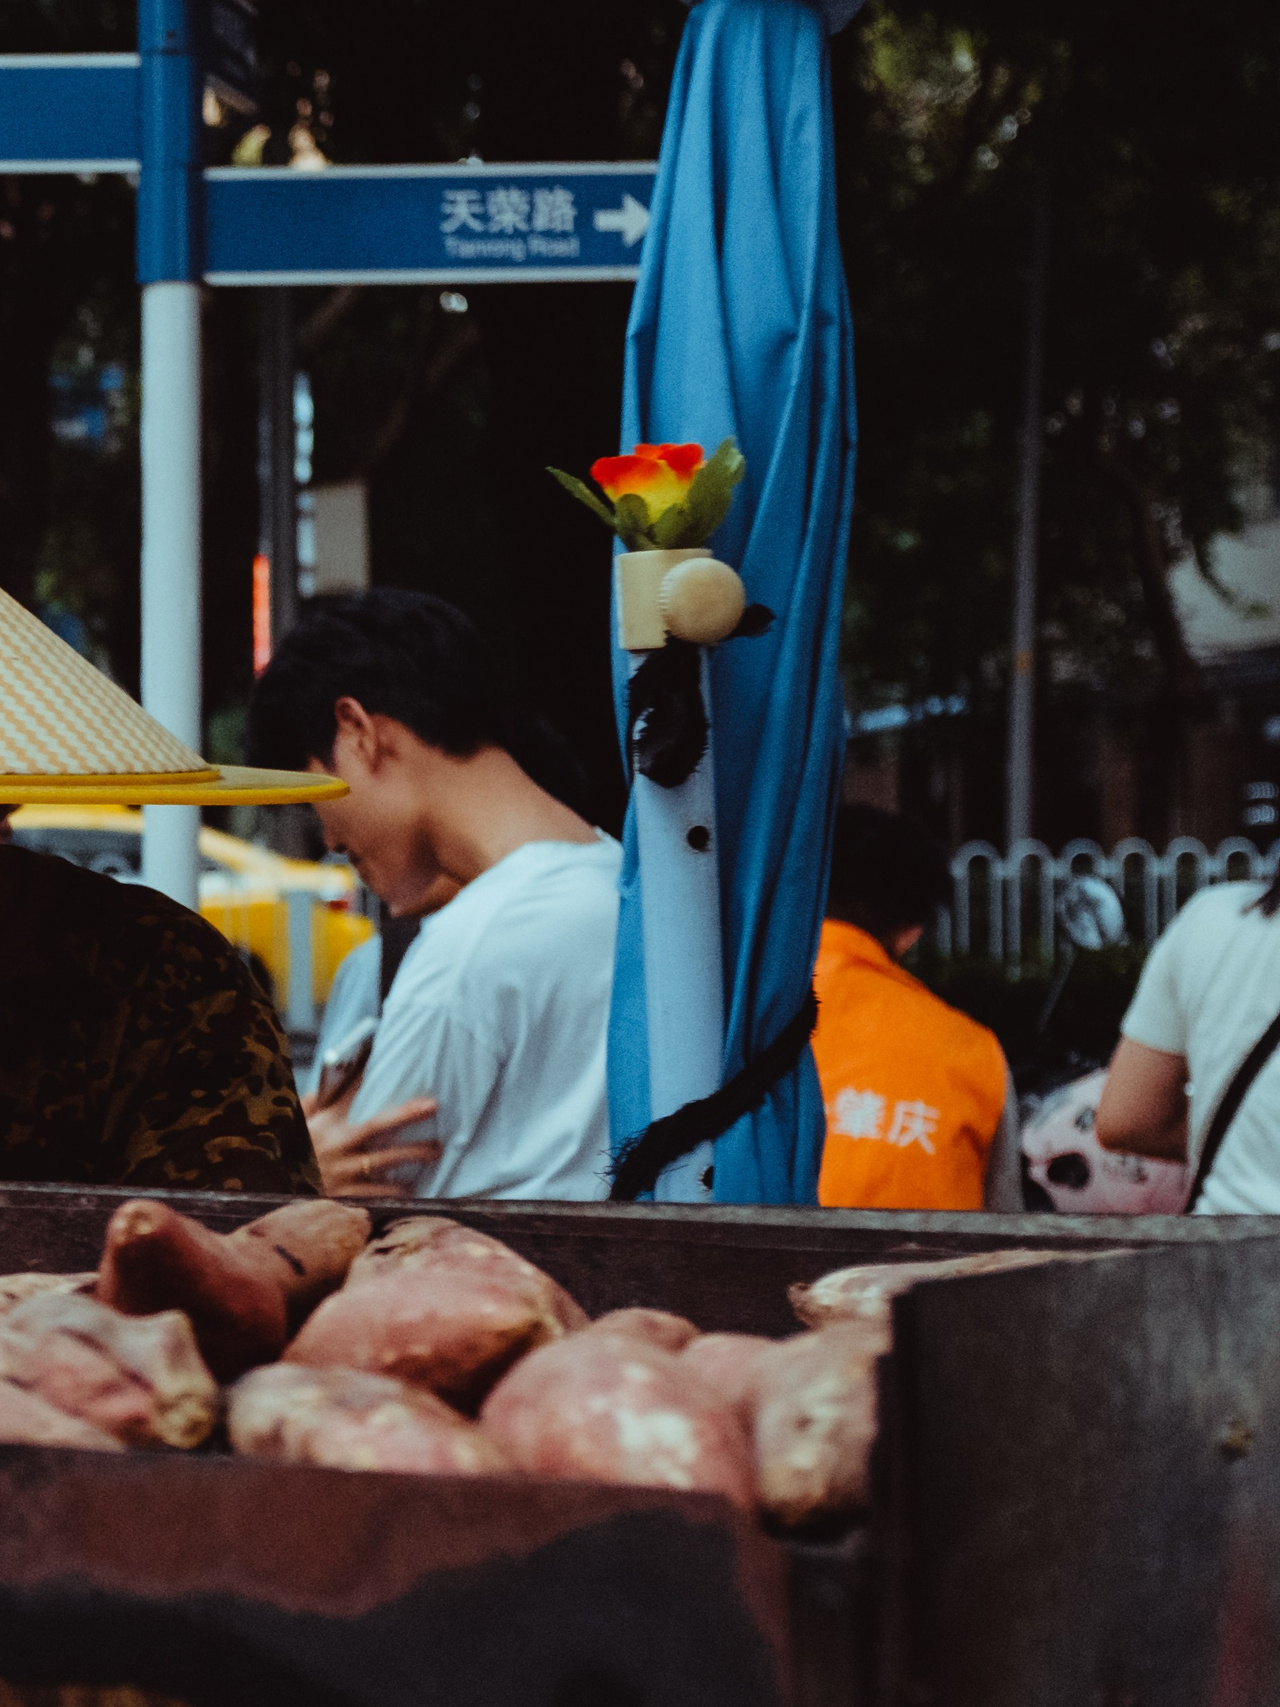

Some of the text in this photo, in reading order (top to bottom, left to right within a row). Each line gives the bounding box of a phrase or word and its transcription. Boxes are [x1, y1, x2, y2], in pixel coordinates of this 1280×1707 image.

[440, 186, 577, 234] 天荣路
[527, 234, 580, 257] Road
[834, 1085, 940, 1155] 肇庆
